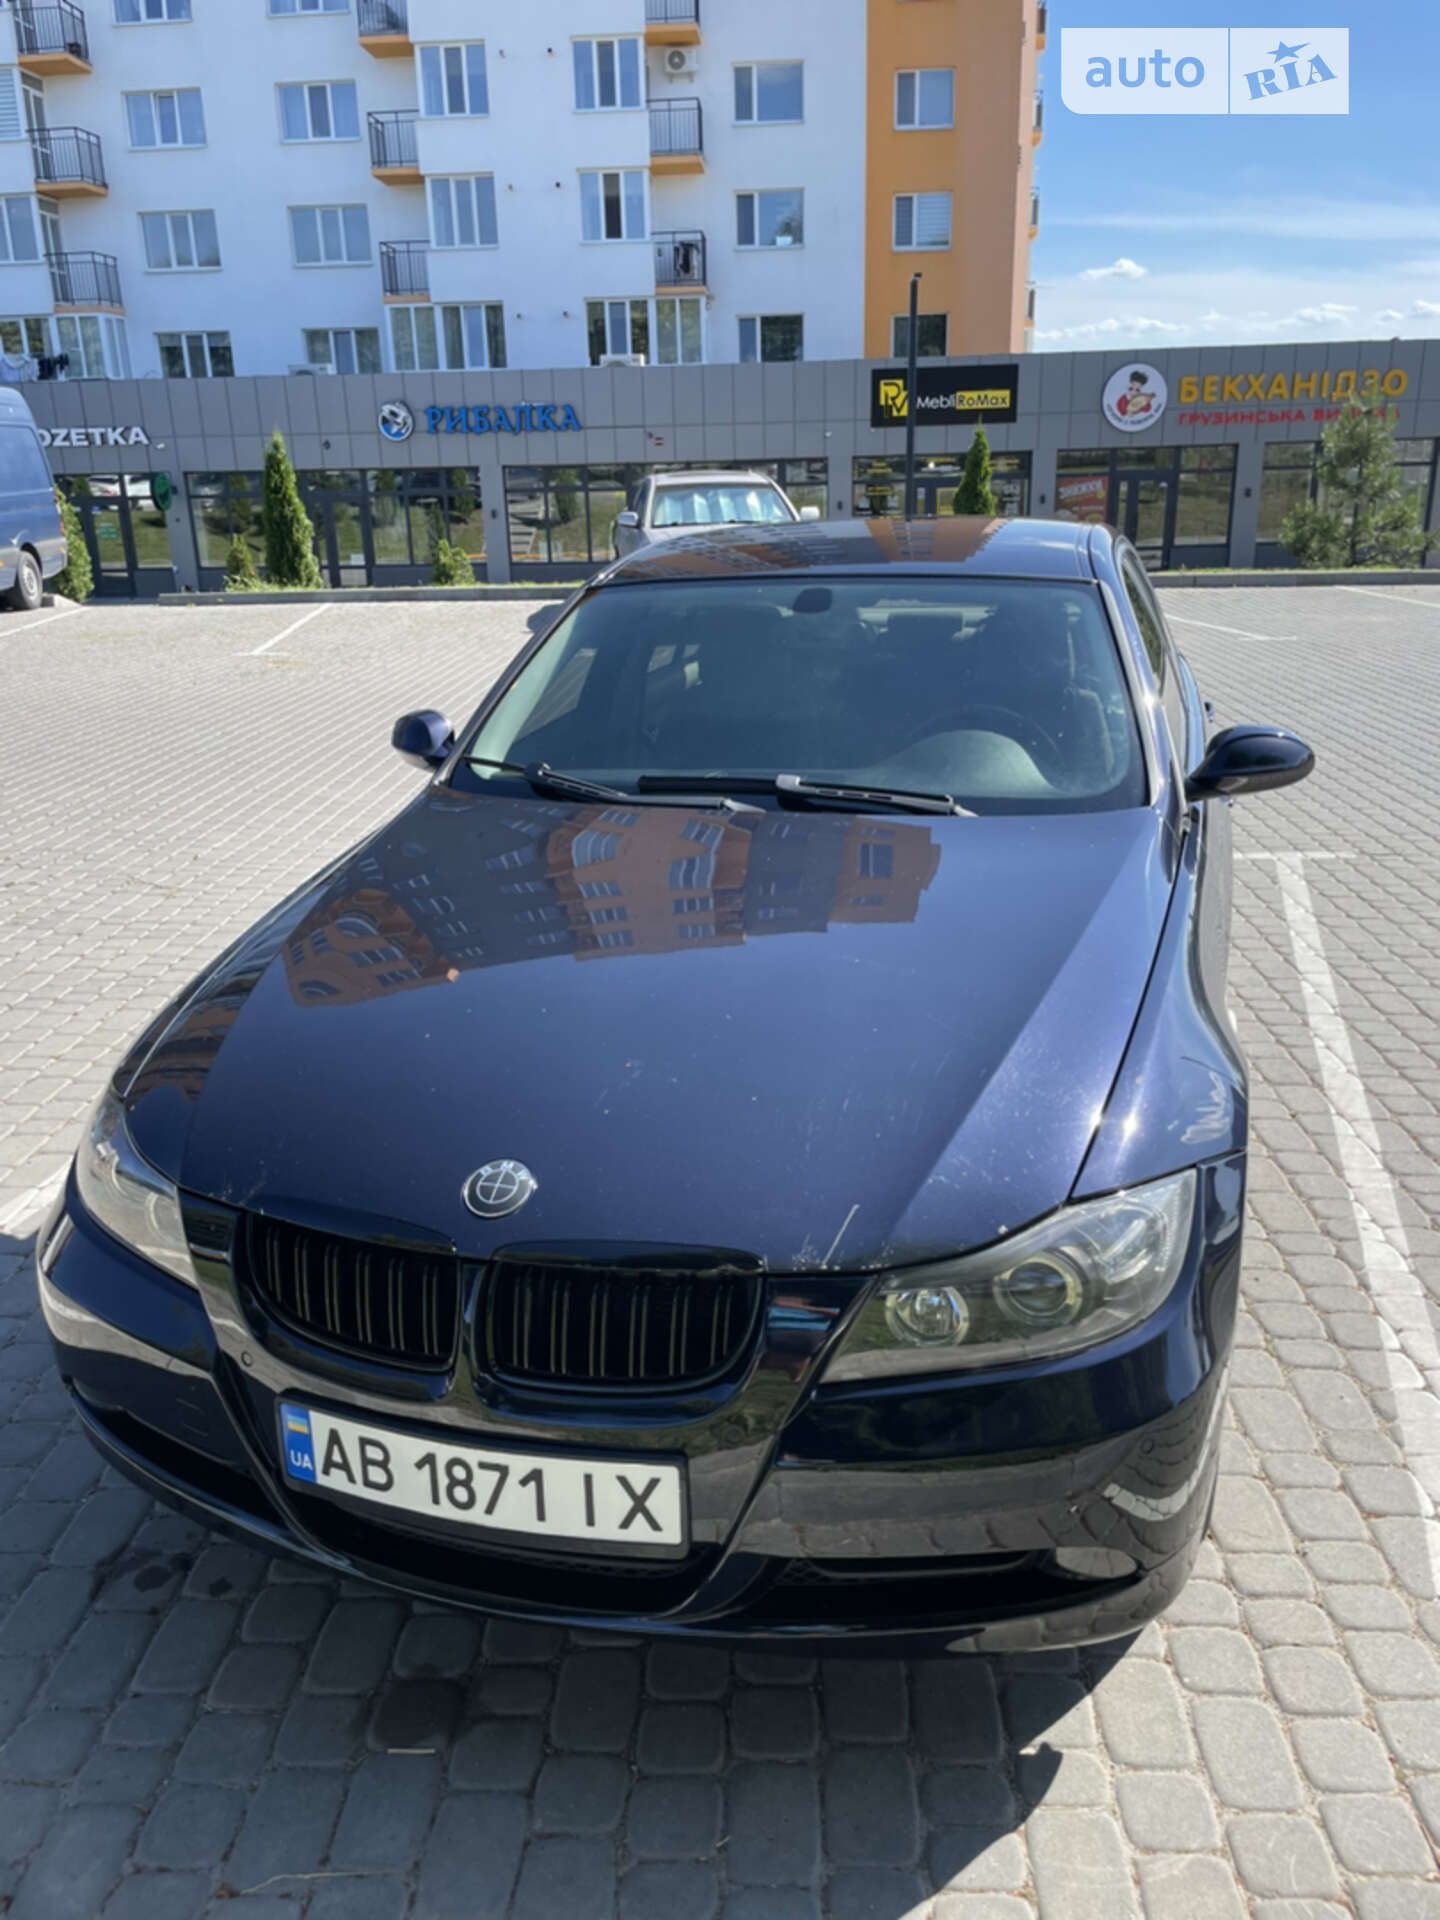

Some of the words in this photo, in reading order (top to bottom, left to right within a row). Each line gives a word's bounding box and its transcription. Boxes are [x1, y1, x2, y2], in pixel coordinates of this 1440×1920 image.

[1178, 369, 1408, 403] БЕКХАНІДЗО
[424, 404, 582, 435] РИБАЛКА
[1177, 408, 1306, 426] ГРУЗИНСЬКА
[290, 1449, 313, 1471] UA
[321, 1427, 394, 1492] AB
[414, 1452, 546, 1522] 1871
[583, 1473, 664, 1532] IX
